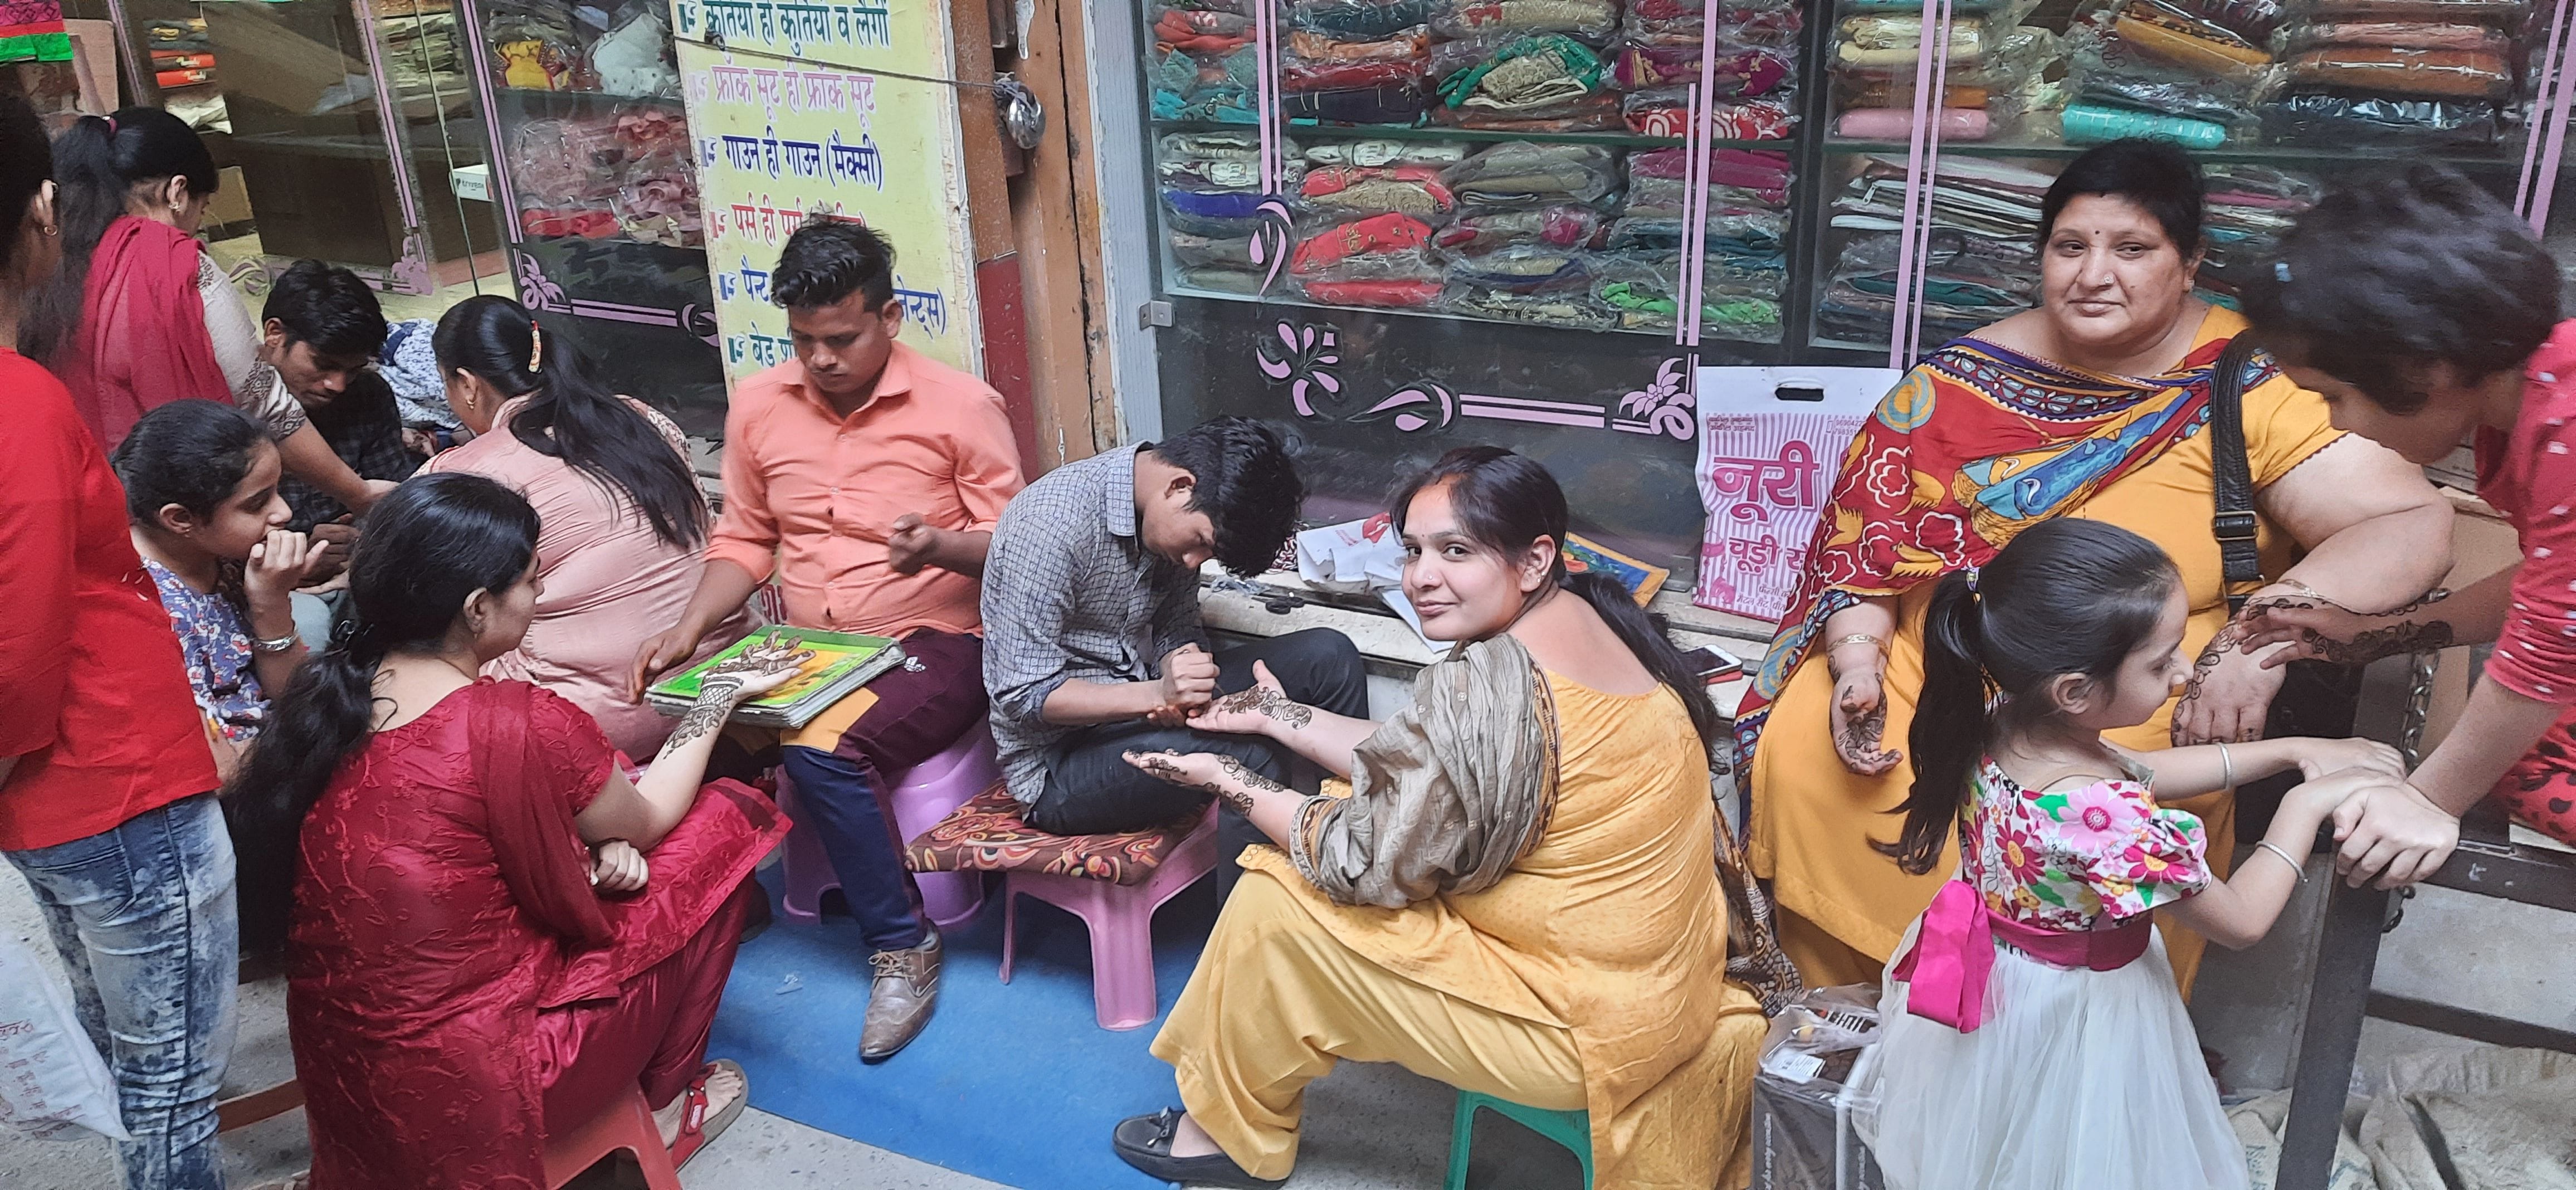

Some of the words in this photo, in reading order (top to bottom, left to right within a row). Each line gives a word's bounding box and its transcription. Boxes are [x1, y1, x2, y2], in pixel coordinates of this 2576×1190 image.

[834, 7, 851, 45] व
[753, 69, 780, 120] सूट
[846, 75, 875, 128] सूट
[721, 135, 761, 172] गाउन
[763, 125, 780, 179] ही
[782, 140, 822, 178] गाउन
[826, 129, 882, 191] (मैक्सी)
[731, 192, 758, 241] पर्स
[759, 194, 776, 247] ही
[749, 321, 774, 367] बेड
[1713, 440, 1820, 523] नूरी
[1729, 534, 1781, 574] चूड़ी
